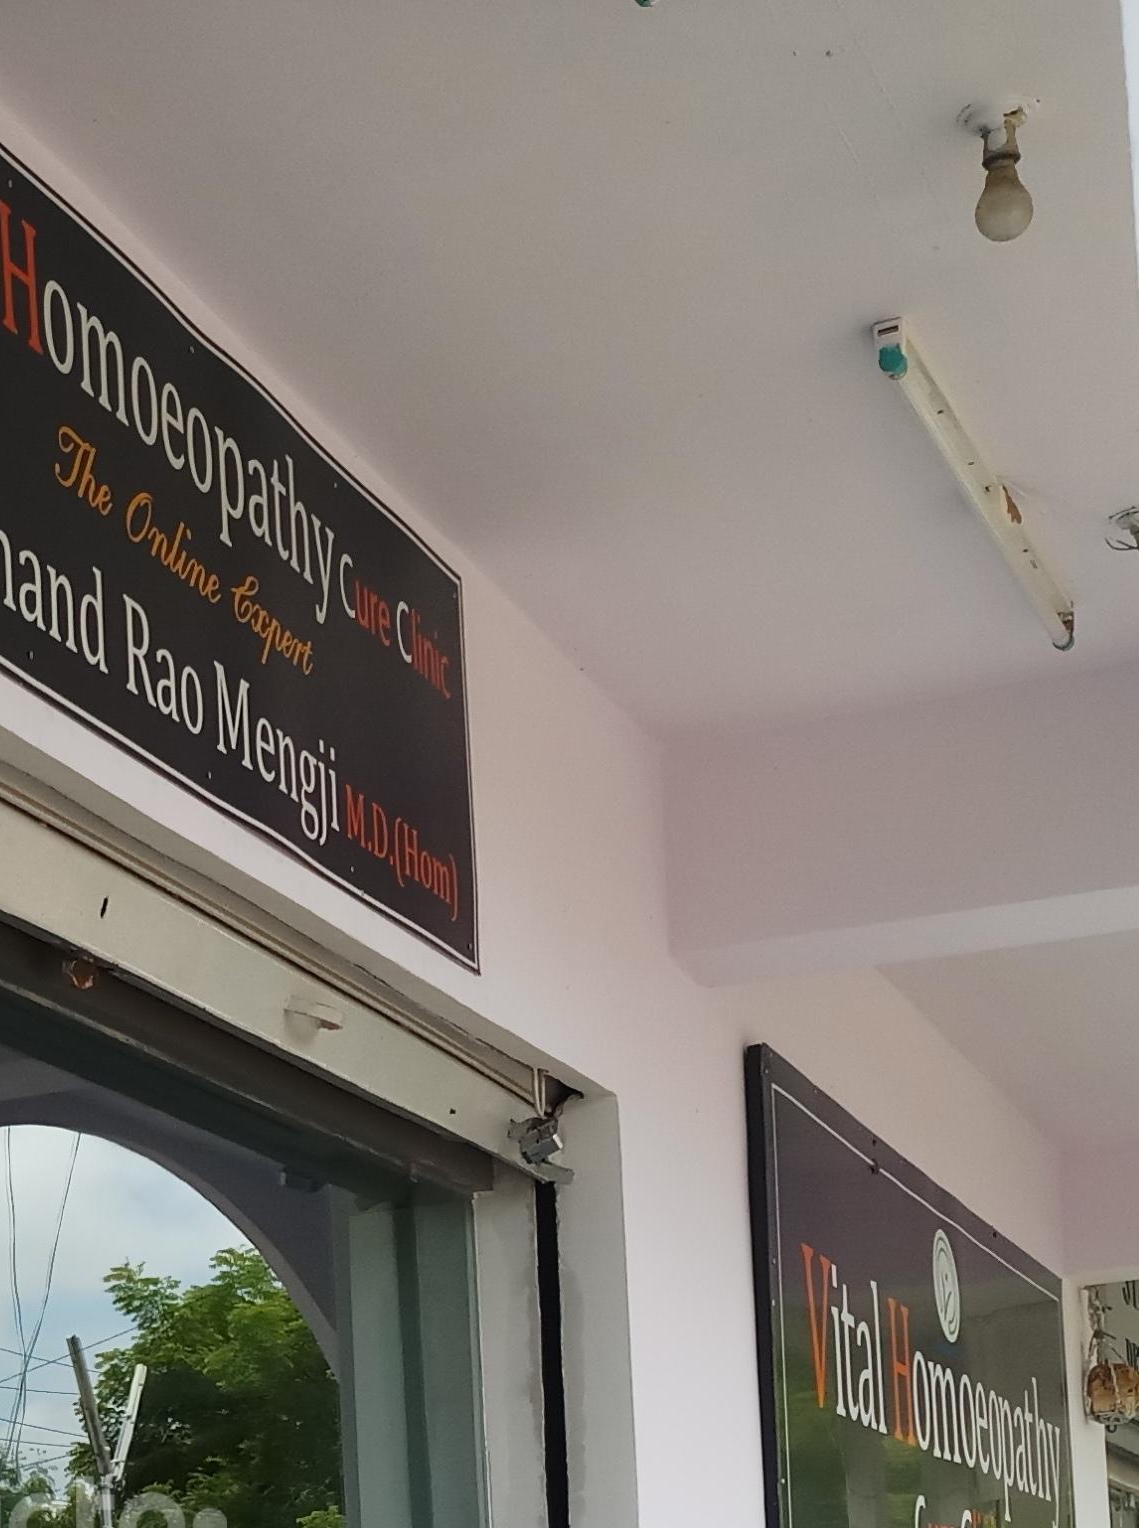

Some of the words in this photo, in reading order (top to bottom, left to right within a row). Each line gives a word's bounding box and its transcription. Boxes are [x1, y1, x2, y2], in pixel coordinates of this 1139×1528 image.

[53, 425, 113, 516] The
[126, 491, 221, 604] Online
[231, 575, 313, 675] Expert
[339, 548, 391, 647] Cure
[396, 600, 451, 699] Clinic
[122, 594, 204, 735] Rao
[212, 660, 340, 846] Mengji
[345, 784, 458, 922] M.D.(Hom)
[801, 1242, 888, 1435] Vital
